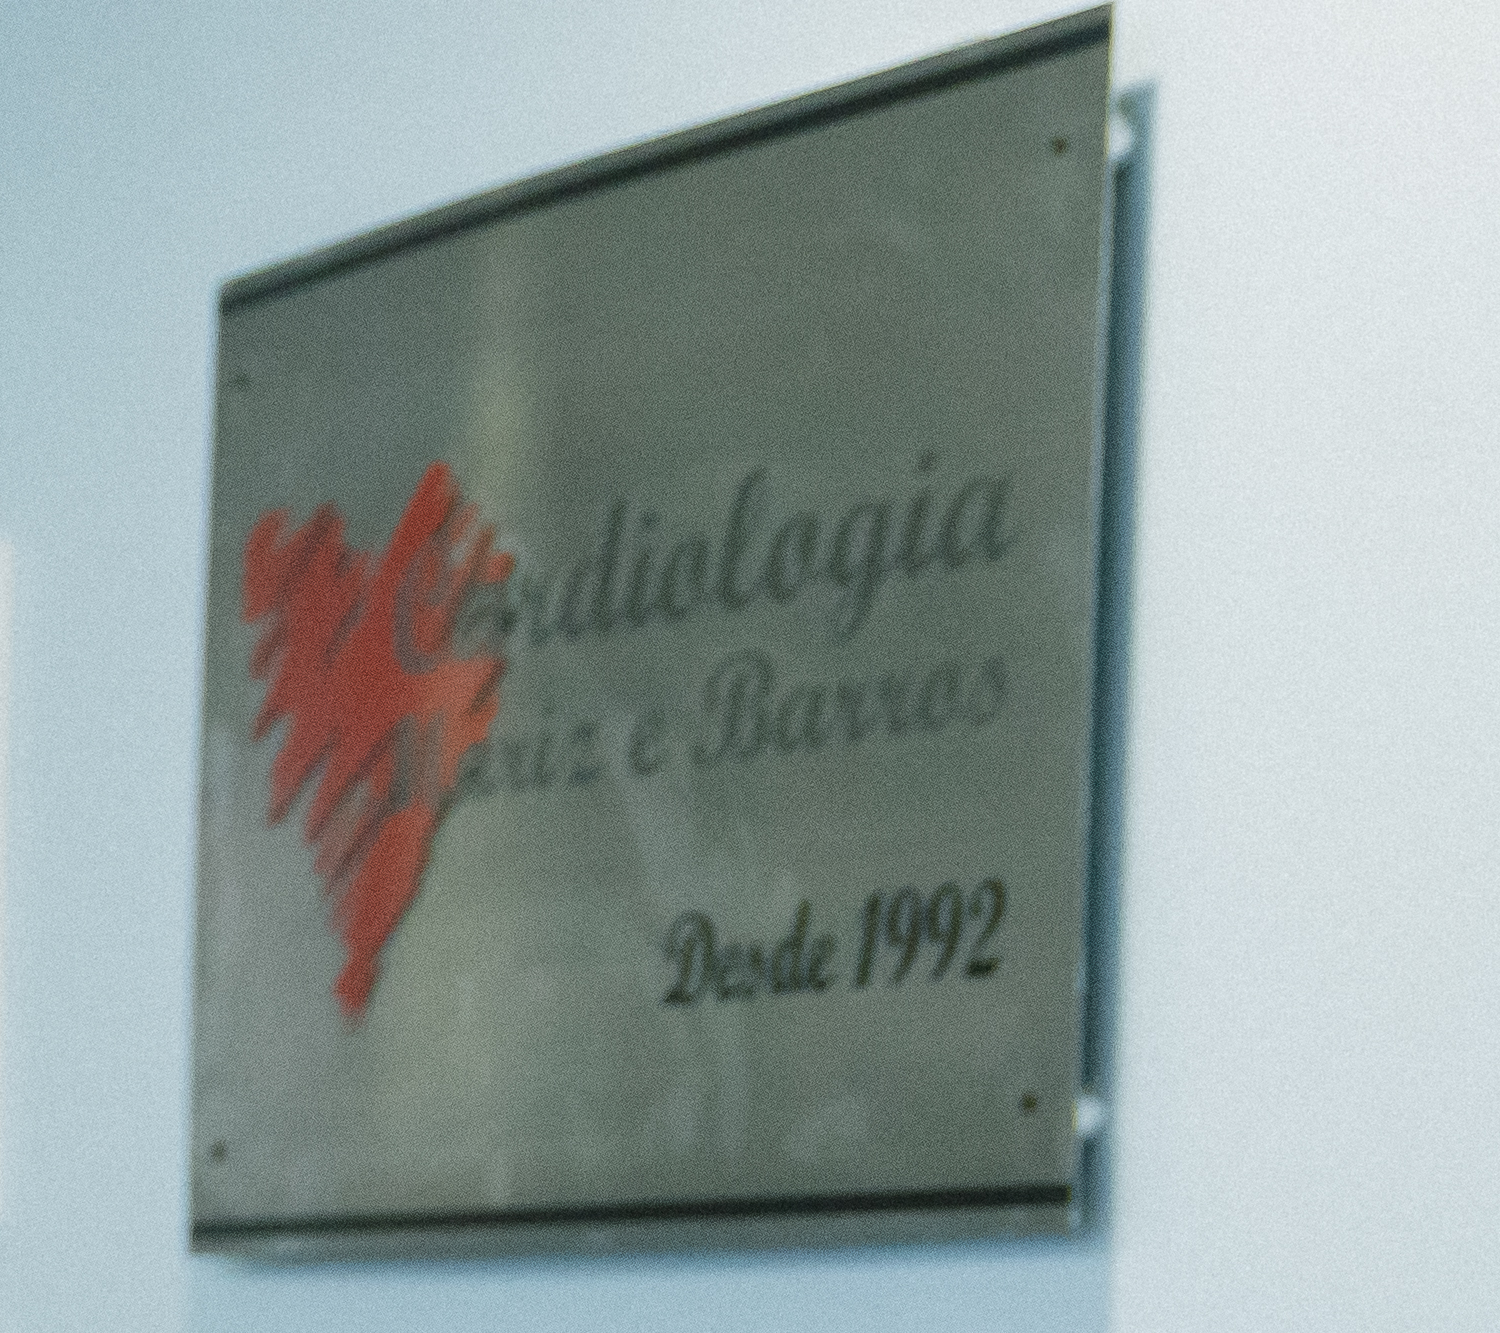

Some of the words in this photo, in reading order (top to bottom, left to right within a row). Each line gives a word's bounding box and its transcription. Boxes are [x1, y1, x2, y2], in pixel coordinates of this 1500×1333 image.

[692, 648, 1008, 766] Barros
[658, 898, 838, 1008] Desde
[852, 877, 1008, 990] 1992
